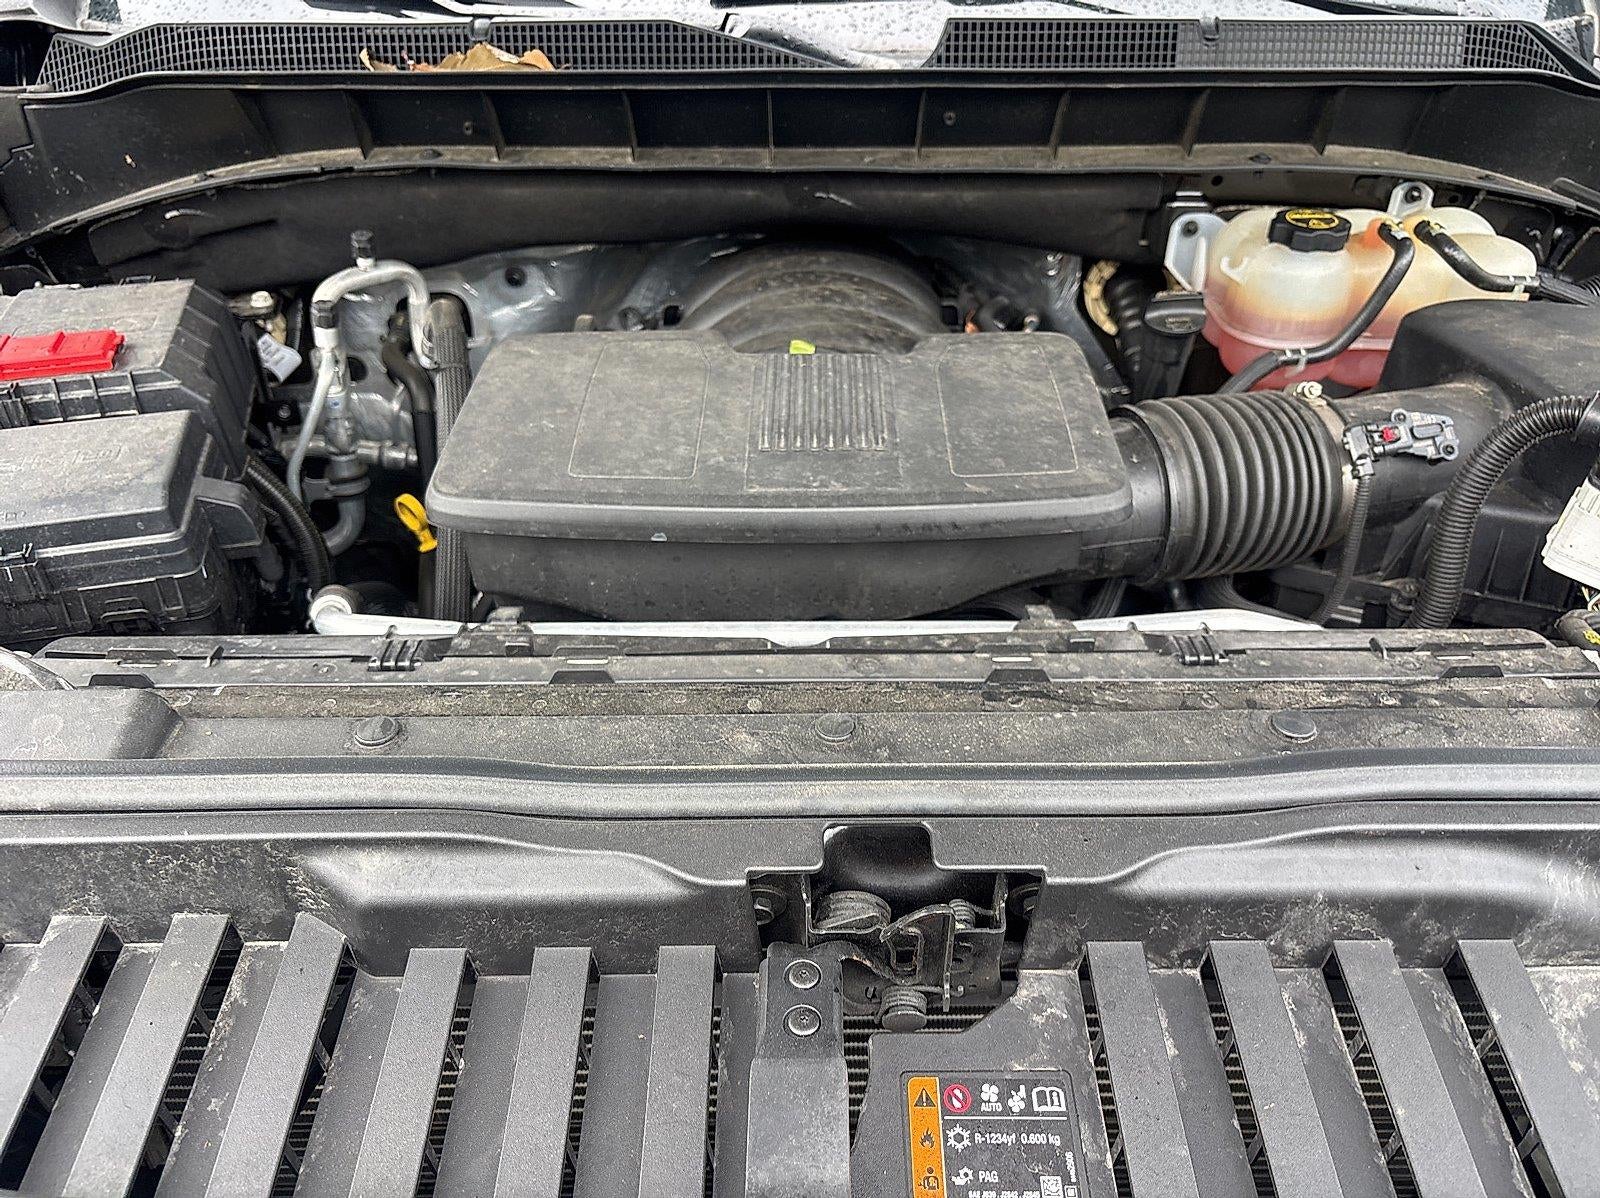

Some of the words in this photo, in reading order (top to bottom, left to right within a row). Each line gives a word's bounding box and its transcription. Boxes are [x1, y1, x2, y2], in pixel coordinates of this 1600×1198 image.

[980, 1101, 1003, 1112] AUTO
[974, 1132, 1017, 1147] R-1234yf
[1020, 1132, 1047, 1145] 0.600
[1047, 1132, 1061, 1147] kg
[978, 1170, 999, 1183] PAG
